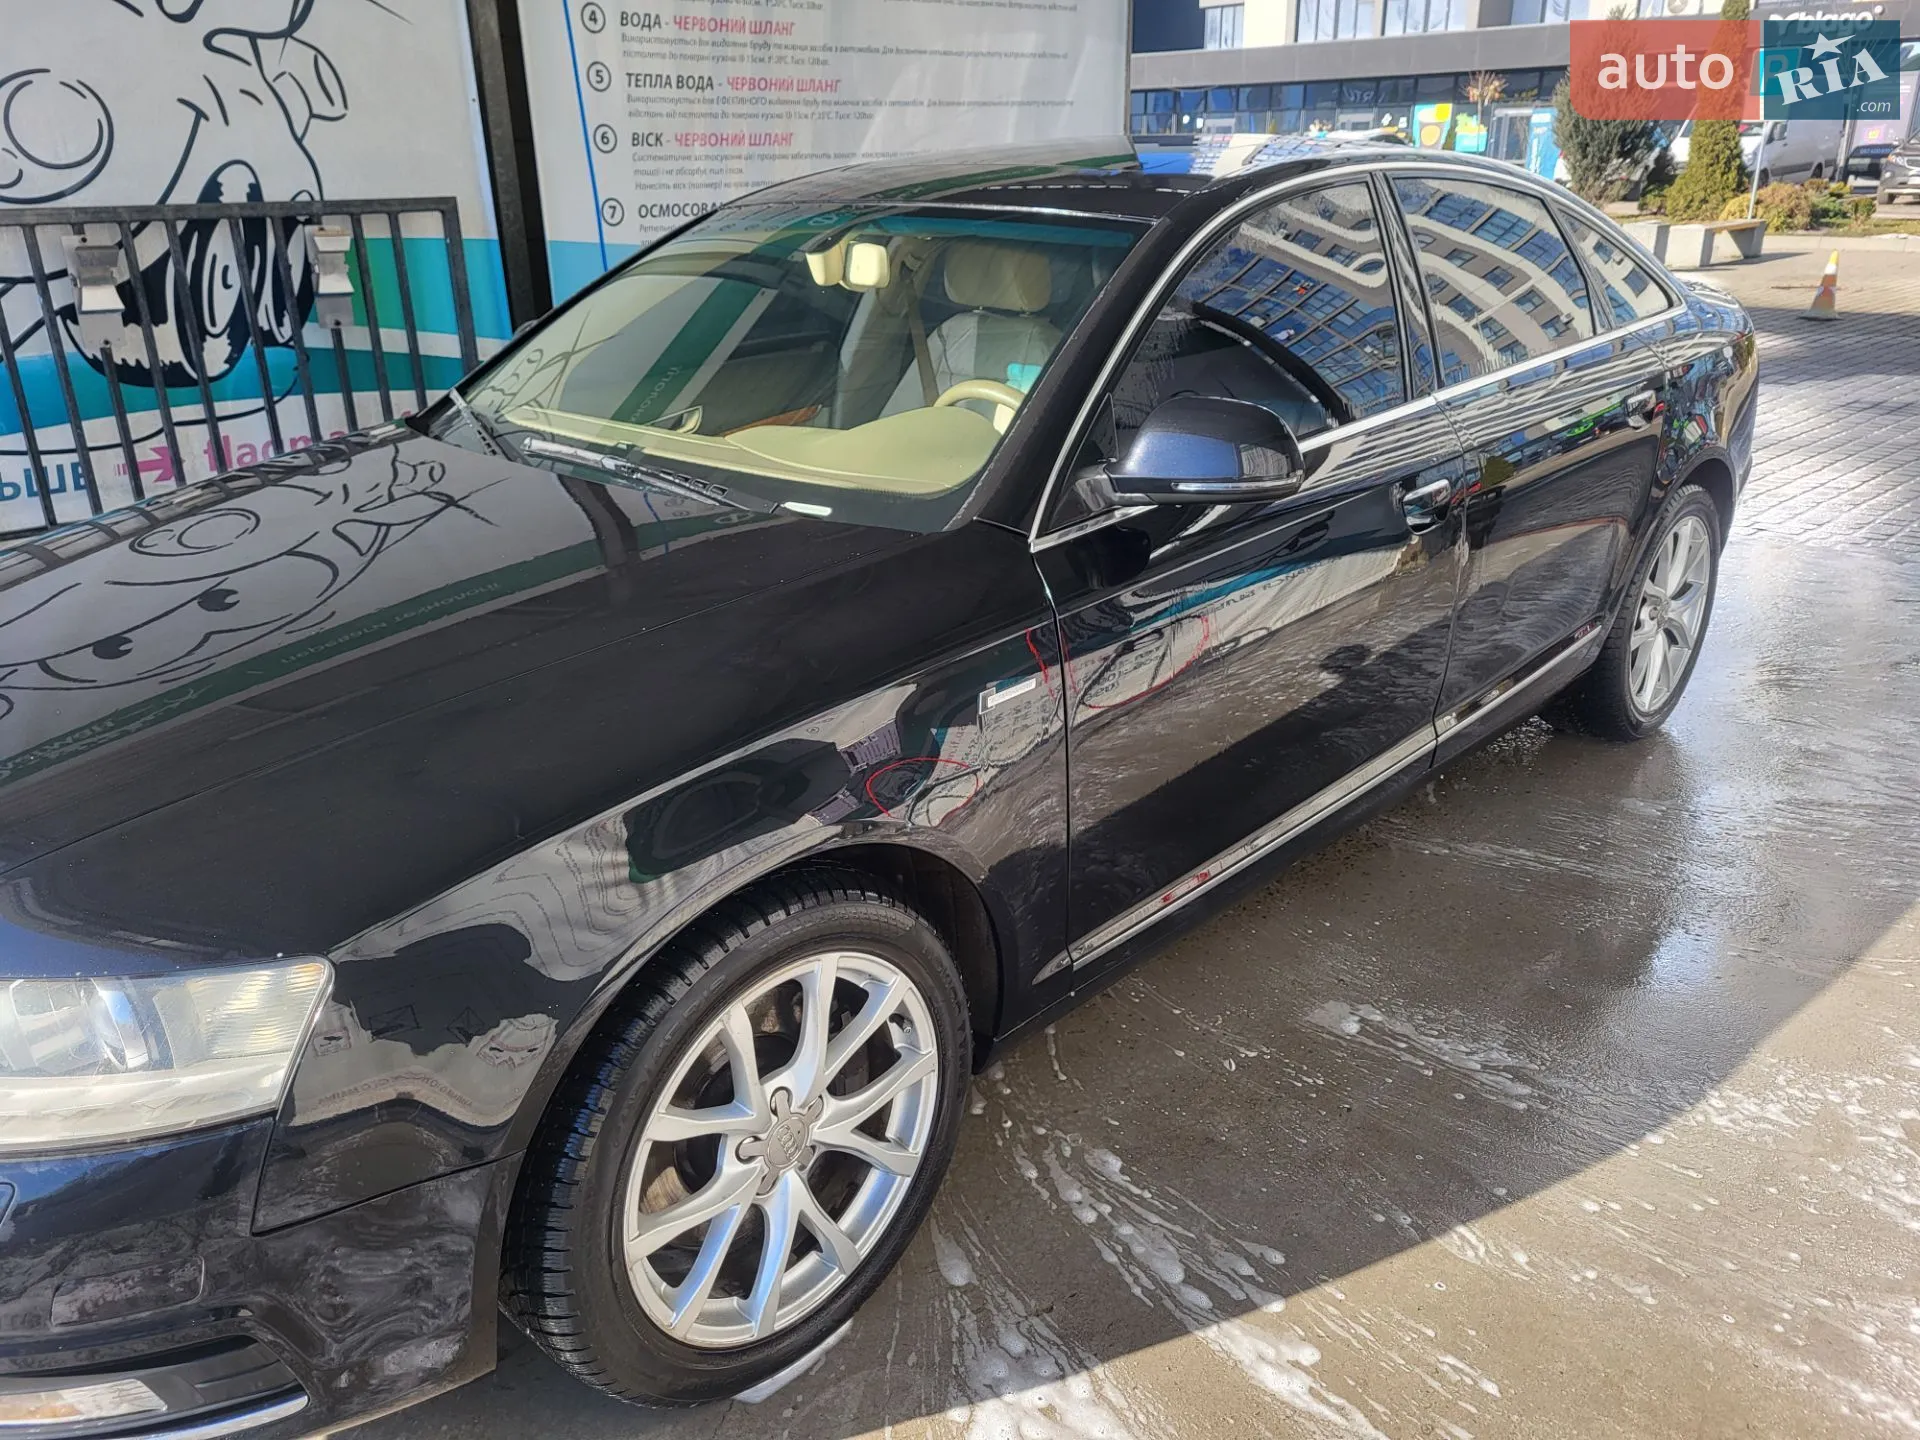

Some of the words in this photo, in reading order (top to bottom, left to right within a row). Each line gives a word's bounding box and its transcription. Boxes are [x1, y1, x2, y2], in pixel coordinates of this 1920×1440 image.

[589, 10, 598, 25] 4
[620, 11, 662, 31] ВОДА
[673, 14, 746, 36] ЧЕРВОНИЙ
[749, 18, 796, 37] ШЛАНГ
[595, 70, 604, 84] 5
[626, 72, 673, 90] ТЕПЛА
[676, 74, 714, 93] ВОДА
[727, 76, 794, 93] ЧЕРВОНИЙ
[797, 78, 841, 93] ШЛАНГ
[601, 132, 609, 145] 6
[631, 132, 663, 148] ВІСК
[675, 130, 745, 148] ЧЕРВОНИЙ
[749, 132, 794, 147] ШЛАНГ
[609, 206, 617, 219] 7
